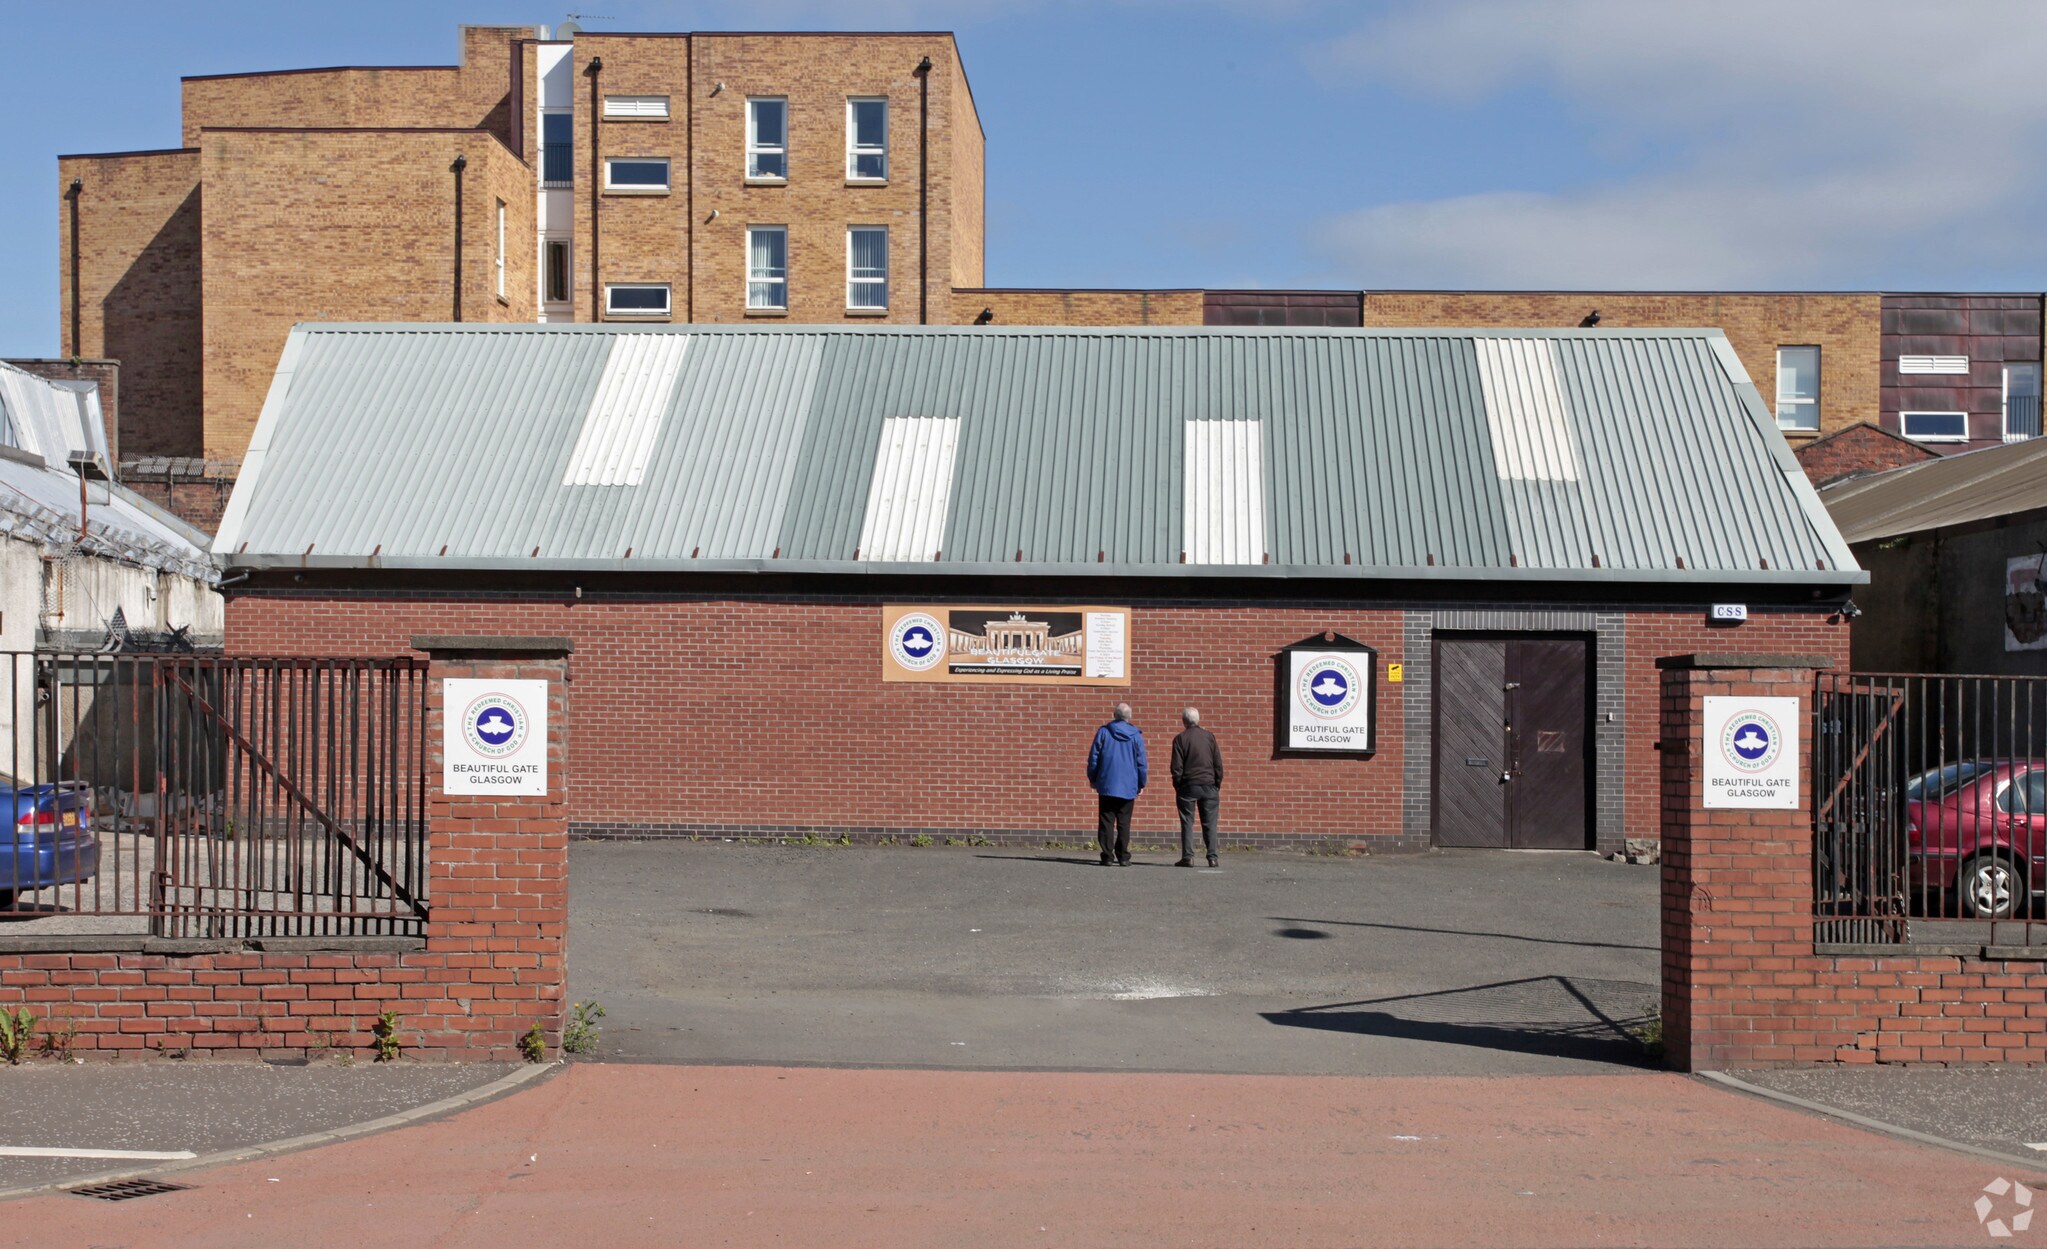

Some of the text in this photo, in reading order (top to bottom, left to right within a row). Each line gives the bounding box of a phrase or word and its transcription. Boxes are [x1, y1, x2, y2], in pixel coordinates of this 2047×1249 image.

[898, 618, 922, 632] REDEEMED
[924, 620, 940, 645] CHRISTIAN
[898, 651, 917, 664] CHURCH
[927, 654, 936, 663] GOD
[1307, 661, 1335, 677] REDEEMED
[1337, 662, 1356, 692] CHRISTIAN
[472, 698, 502, 714] REDEEMED
[503, 700, 523, 730] CHRISTIAN
[1306, 699, 1329, 715] CHURCH
[1340, 702, 1350, 712] GOD
[1293, 725, 1340, 733] BEAUTIFUL
[1730, 714, 1756, 730] REDEEMED
[1758, 716, 1777, 746] CHRISTIAN
[471, 737, 495, 754] CHURCH
[506, 740, 518, 751] GOD
[1307, 735, 1351, 743] GLASGOW
[1729, 752, 1751, 768] CHURCH
[1761, 755, 1772, 766] GOD
[453, 764, 538, 773] BEAUTIFUL GATE
[470, 776, 522, 784] GLASGOW
[1766, 779, 1790, 787] GATE
